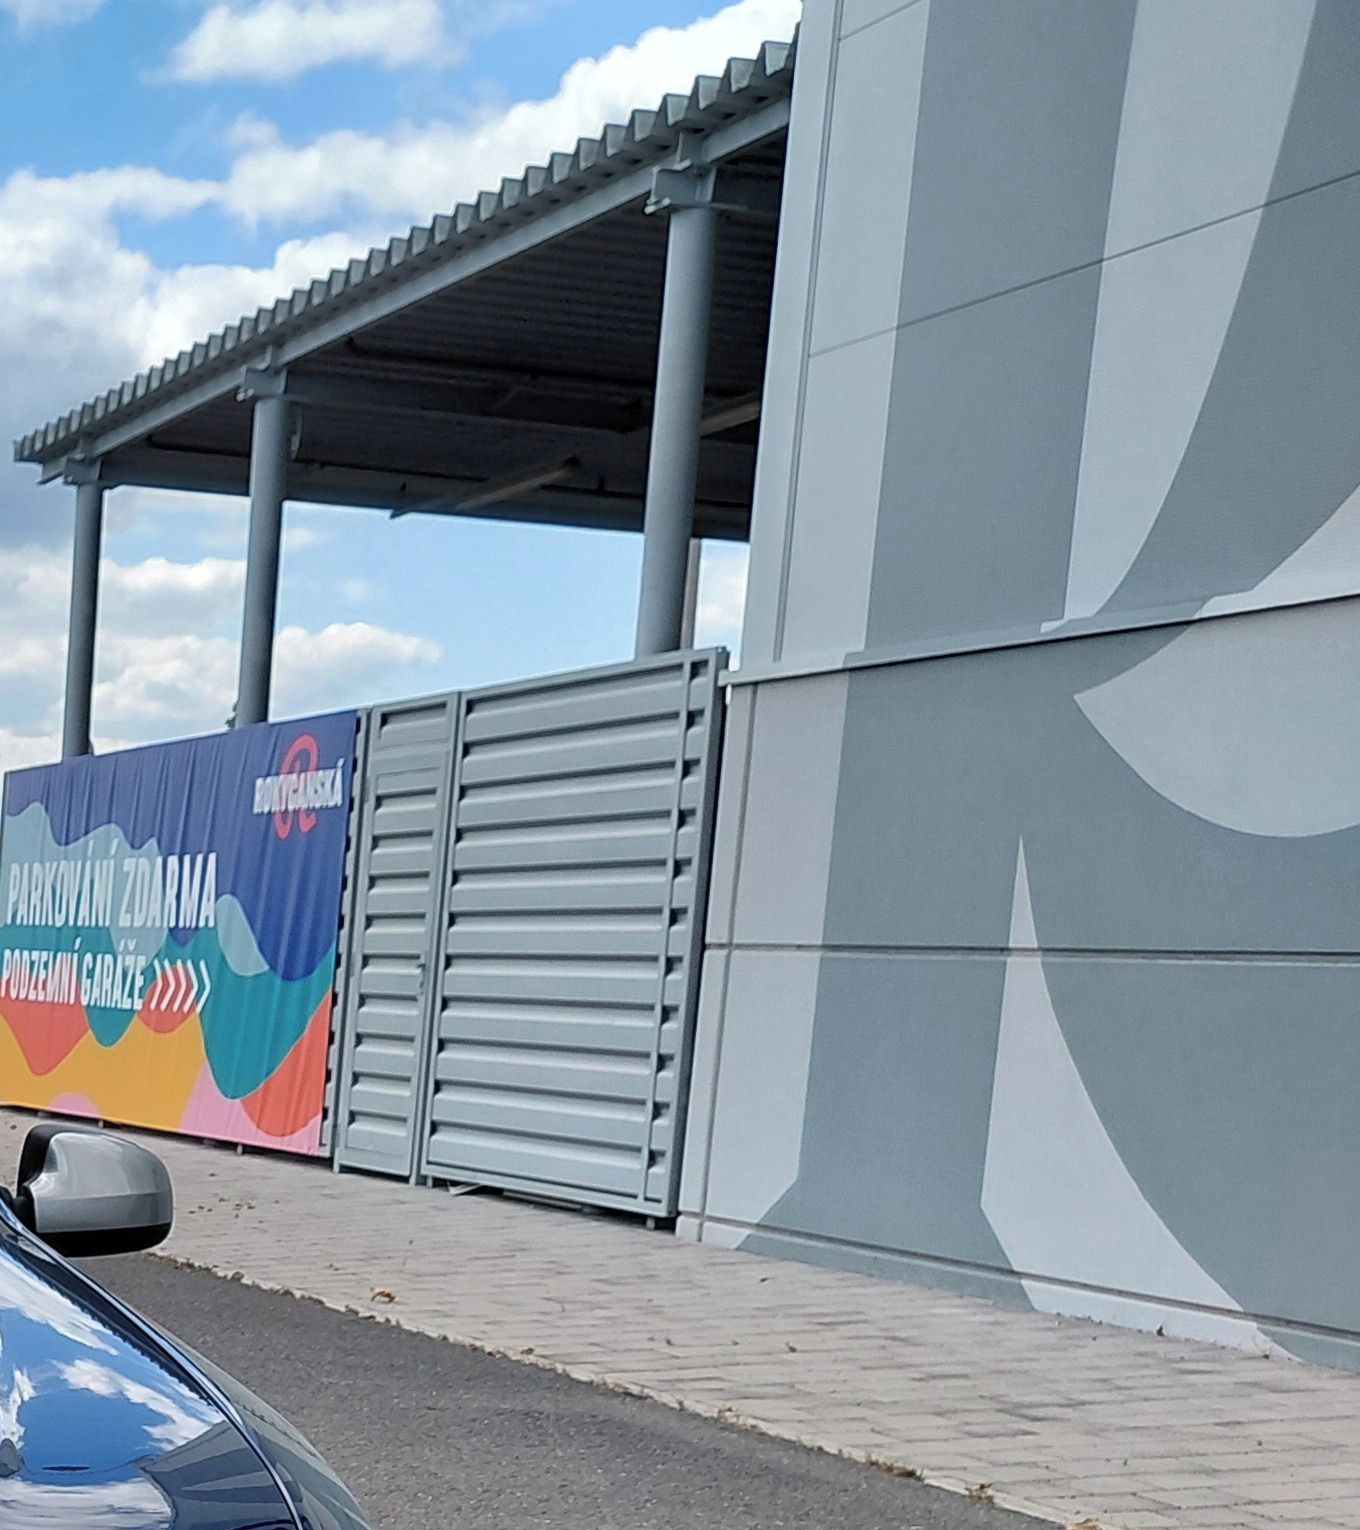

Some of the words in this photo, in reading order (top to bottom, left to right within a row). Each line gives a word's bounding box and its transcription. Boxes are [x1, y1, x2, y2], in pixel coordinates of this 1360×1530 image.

[6, 838, 119, 927] PARKOVÁNÍ
[118, 852, 217, 929] ZDARMA
[0, 936, 82, 1005] PODZEMNÍ
[81, 939, 147, 1011] GARÁŽE
